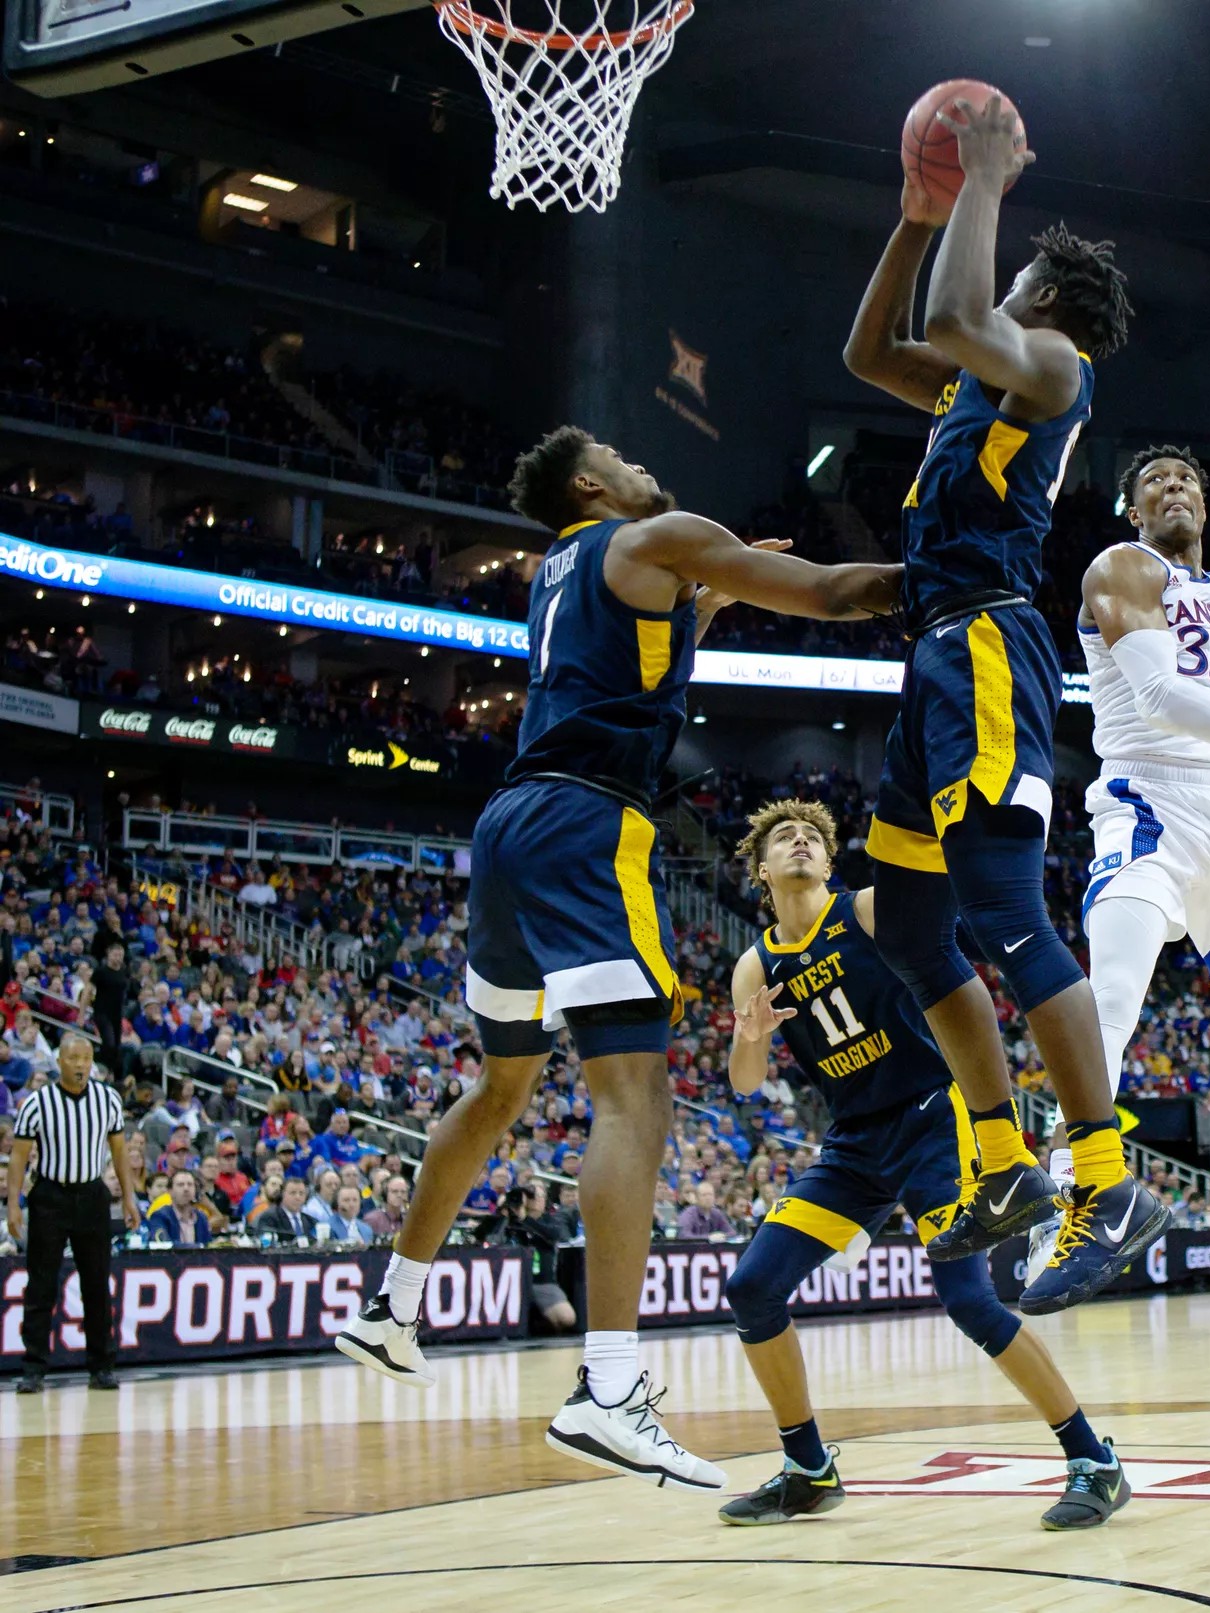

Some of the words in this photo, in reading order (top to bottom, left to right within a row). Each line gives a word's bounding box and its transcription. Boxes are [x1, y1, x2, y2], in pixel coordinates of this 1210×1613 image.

[544, 541, 580, 588] CULVER
[218, 583, 287, 613] Official
[291, 595, 349, 623] Credit
[352, 604, 397, 630] Card
[400, 613, 420, 633] of
[421, 617, 453, 639] the
[456, 621, 485, 648] Big
[487, 626, 507, 647] 12
[541, 587, 564, 677] 1
[99, 707, 153, 733] Coca-Cola
[164, 715, 217, 742] Coca-Cola
[228, 723, 279, 750] Coca-Cola
[347, 746, 386, 767] Sprint
[409, 756, 441, 773] Center
[1108, 855, 1120, 865] KU
[787, 950, 846, 1002] WEST
[810, 985, 867, 1047] 11
[817, 1028, 893, 1078] VIRGINIA
